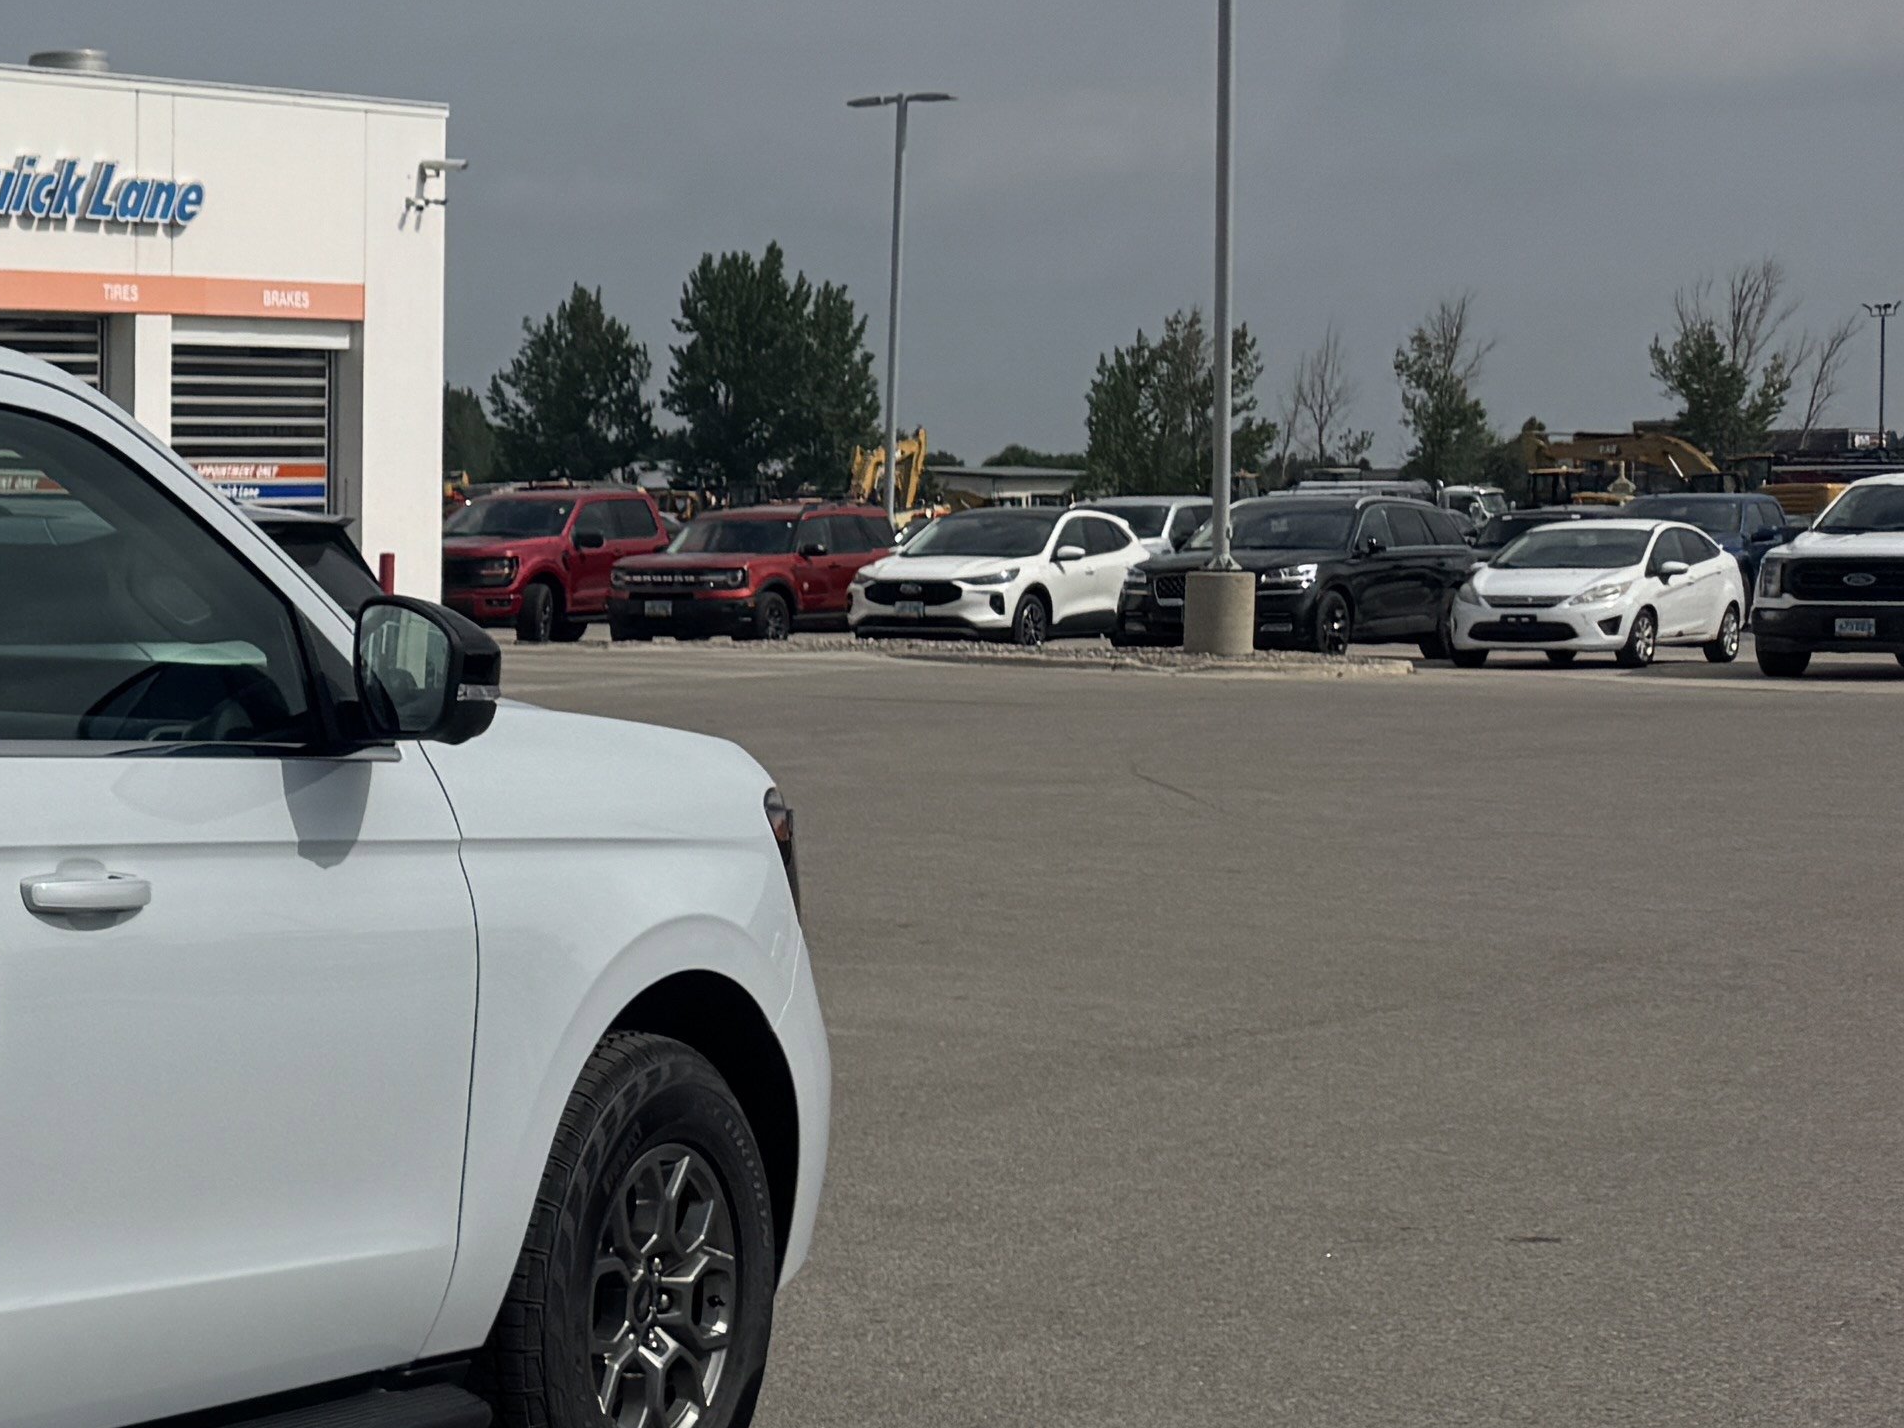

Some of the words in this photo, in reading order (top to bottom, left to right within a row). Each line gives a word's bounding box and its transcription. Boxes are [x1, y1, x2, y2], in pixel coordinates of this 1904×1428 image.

[85, 162, 205, 225] Lane
[103, 283, 139, 302] TIRES
[263, 289, 310, 309] BRAKES
